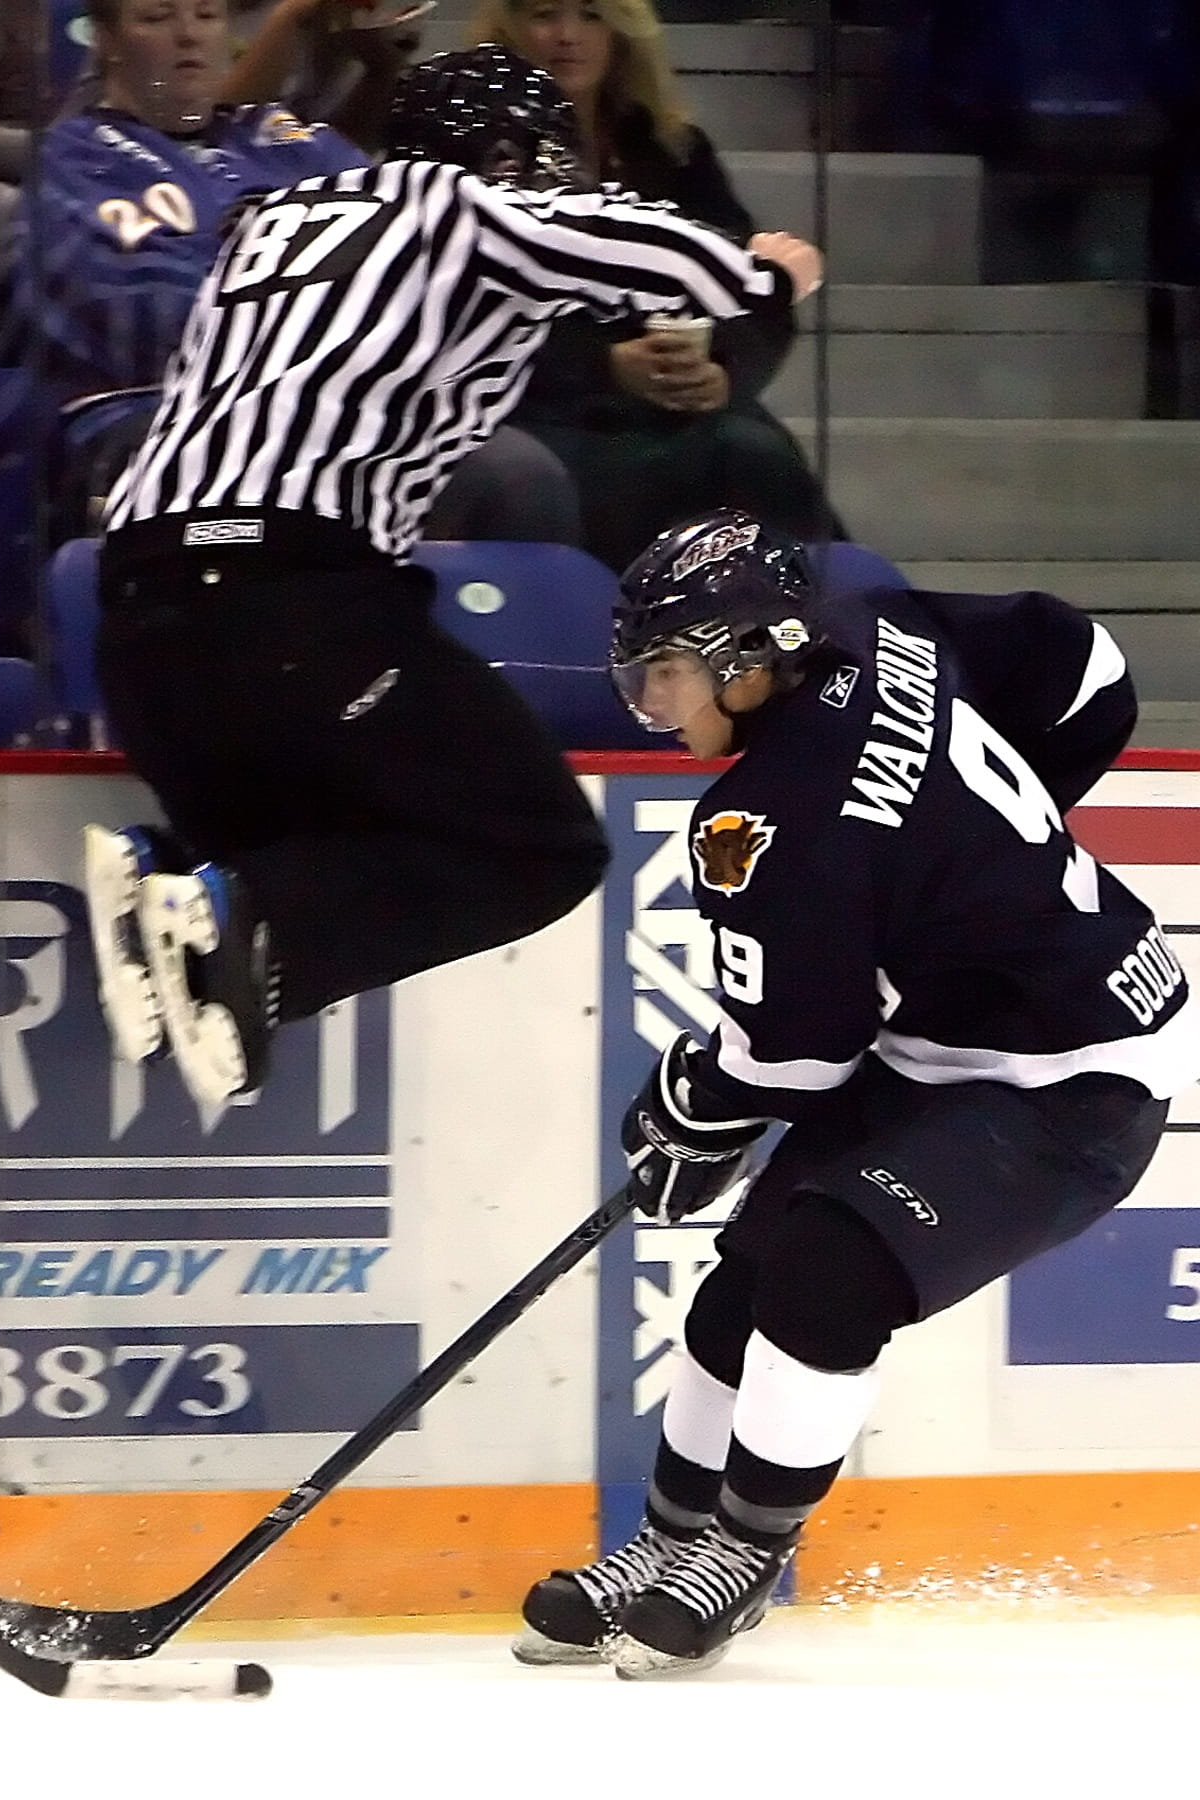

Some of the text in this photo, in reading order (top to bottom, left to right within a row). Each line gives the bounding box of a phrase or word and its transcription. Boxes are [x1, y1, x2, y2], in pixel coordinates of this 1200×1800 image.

[97, 182, 197, 251] 20
[221, 201, 381, 293] 87
[840, 617, 938, 828] WALCHUK
[871, 1168, 931, 1220] CCM
[240, 1246, 391, 1295] MIX
